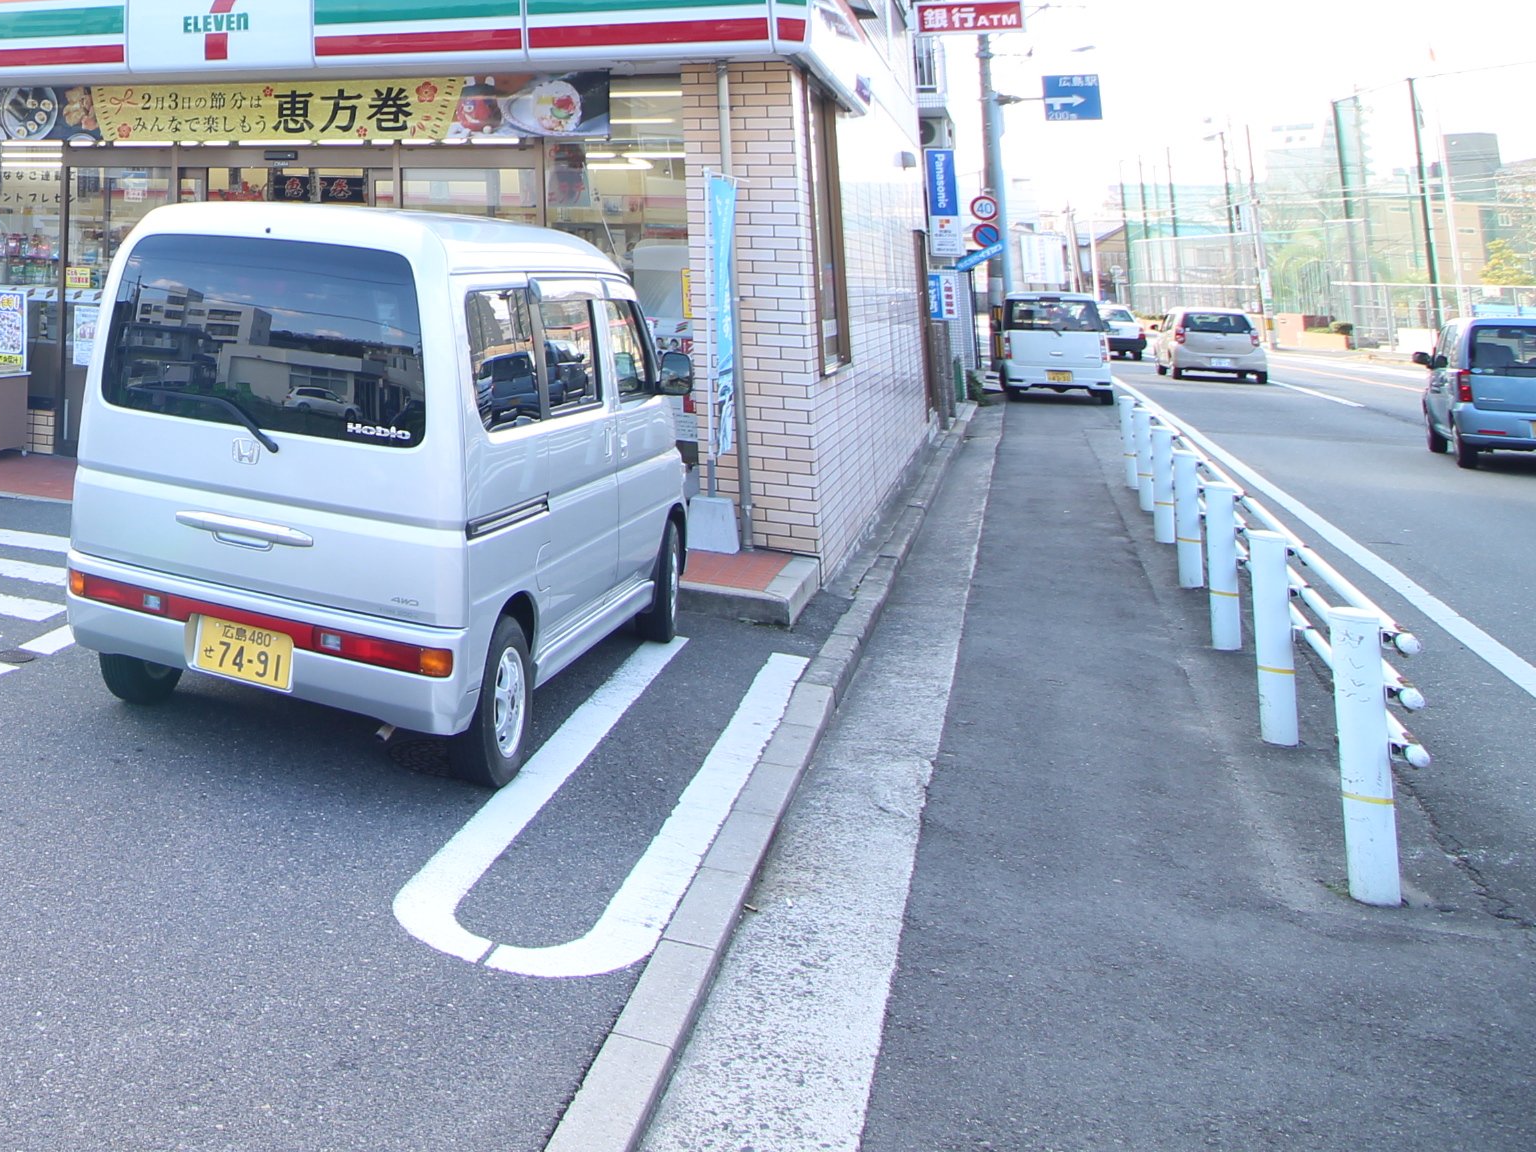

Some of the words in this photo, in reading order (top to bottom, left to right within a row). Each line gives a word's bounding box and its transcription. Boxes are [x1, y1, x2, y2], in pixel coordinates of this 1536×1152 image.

[141, 91, 263, 111] 2月3日の節分は
[272, 87, 414, 134] 恵方巻
[131, 114, 267, 135] みんなで楽しもう
[935, 153, 947, 209] Panasonic
[977, 203, 993, 214] 40
[204, 645, 215, 659] せ
[218, 640, 281, 682] 74-91
